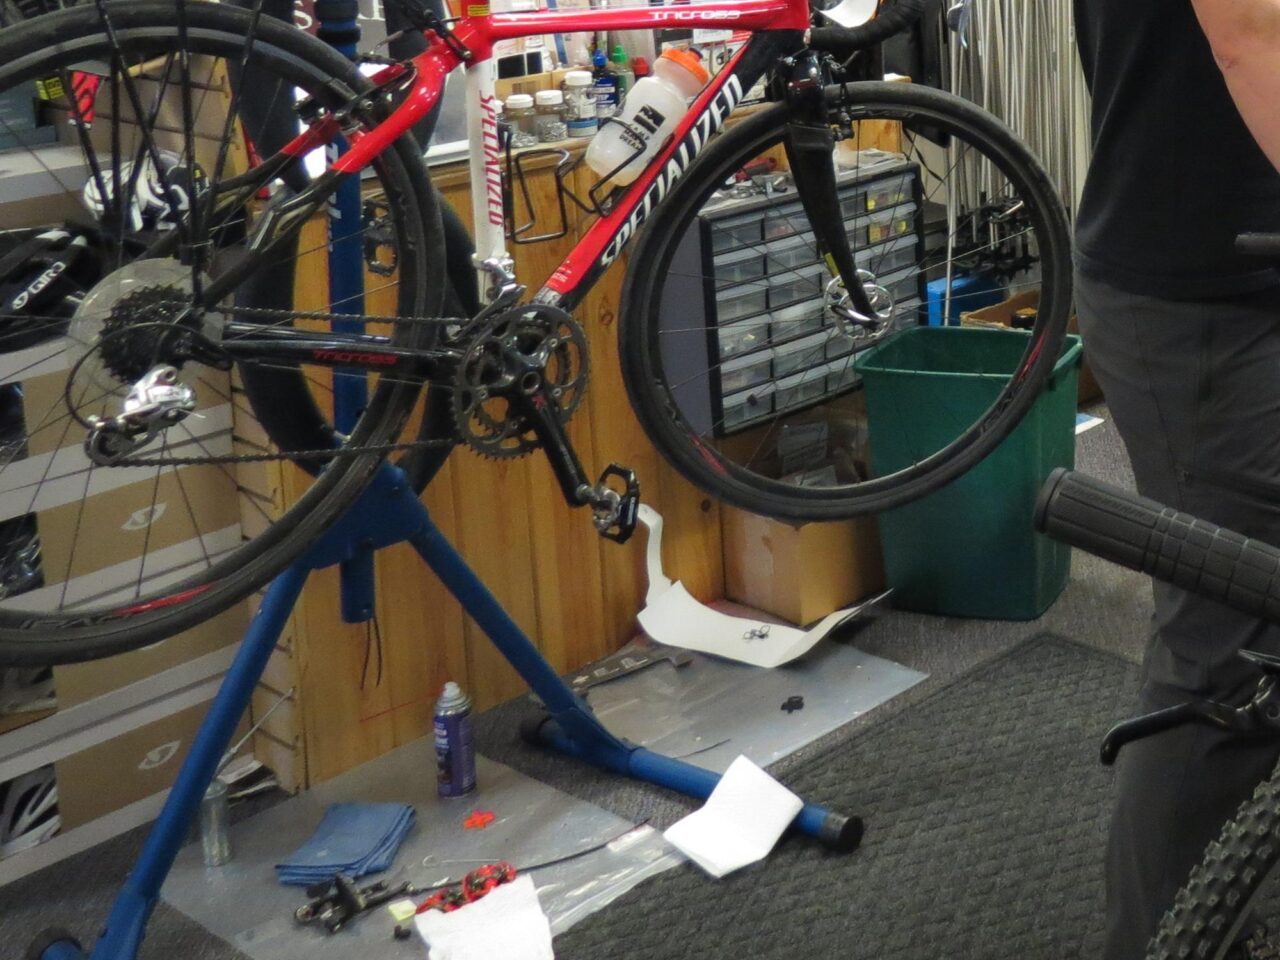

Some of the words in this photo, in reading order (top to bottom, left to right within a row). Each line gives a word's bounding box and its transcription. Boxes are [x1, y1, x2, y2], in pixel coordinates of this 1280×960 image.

[480, 90, 504, 226] SPECIALIZED
[601, 74, 744, 268] SPECIALIZED
[28, 261, 66, 294] GIRO
